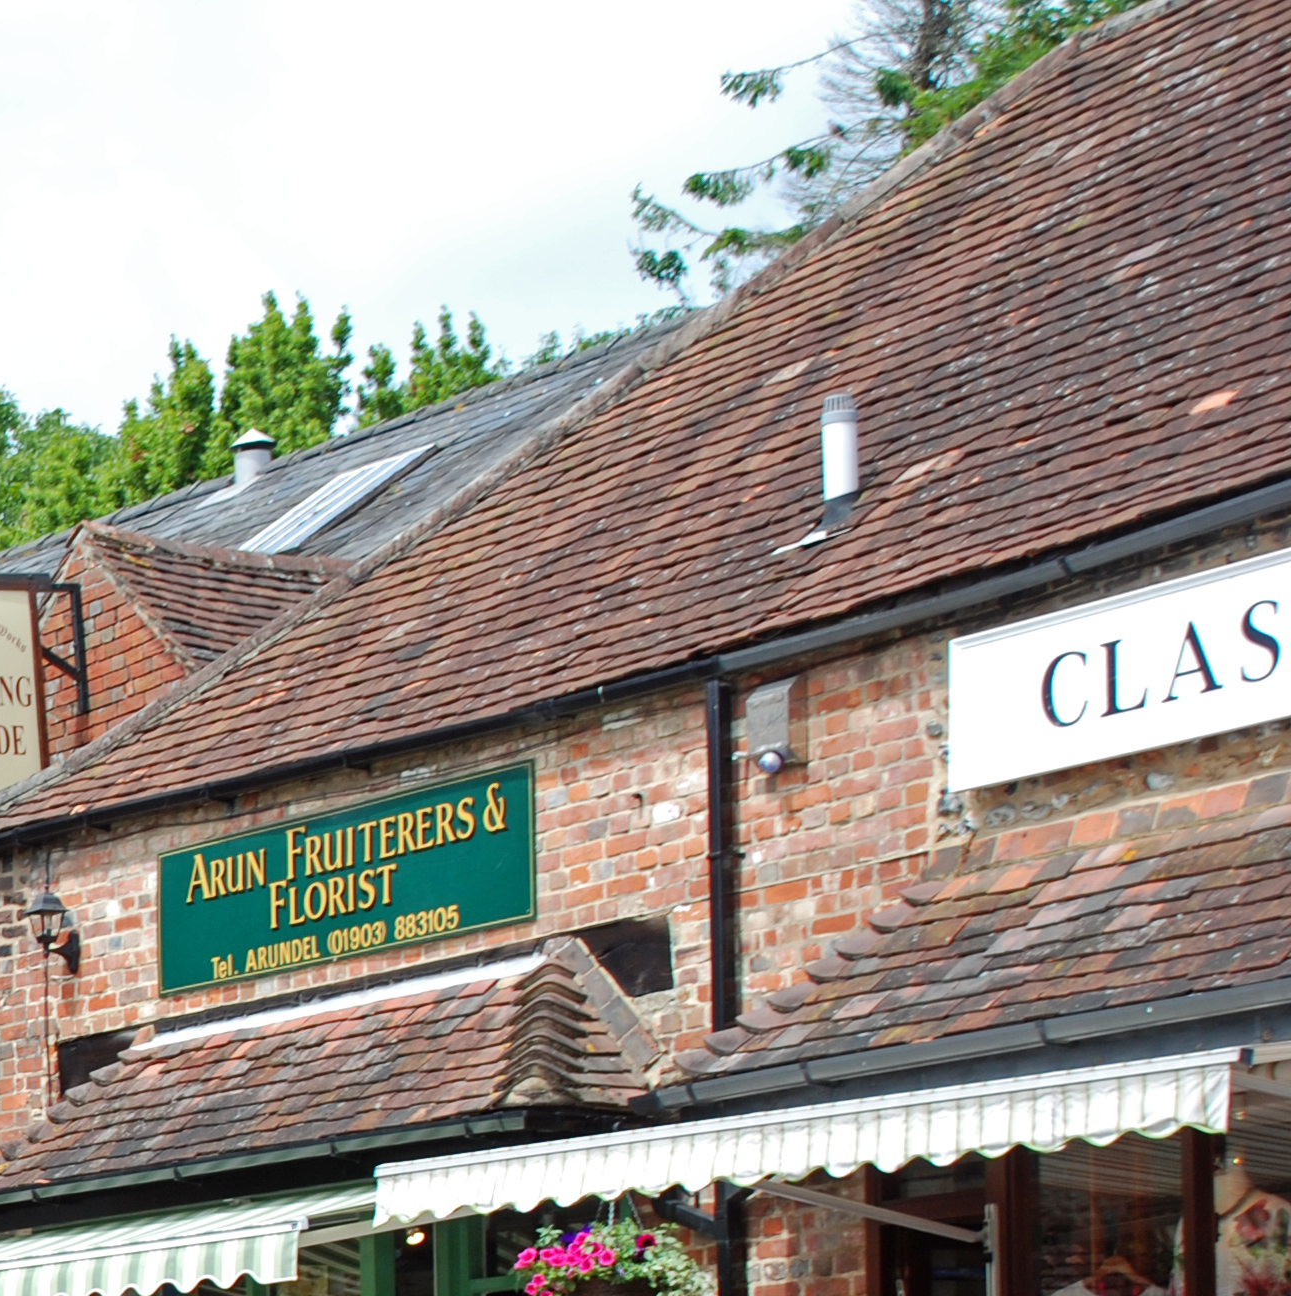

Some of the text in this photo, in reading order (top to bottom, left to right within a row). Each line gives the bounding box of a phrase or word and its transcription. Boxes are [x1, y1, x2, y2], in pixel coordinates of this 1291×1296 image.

[1040, 599, 1282, 728] CLAS
[185, 781, 508, 904] ARUN FRUITERERS &
[210, 904, 461, 981] Tel. ARUNDEL (01903) 883105
[268, 862, 399, 931] FLORIST
